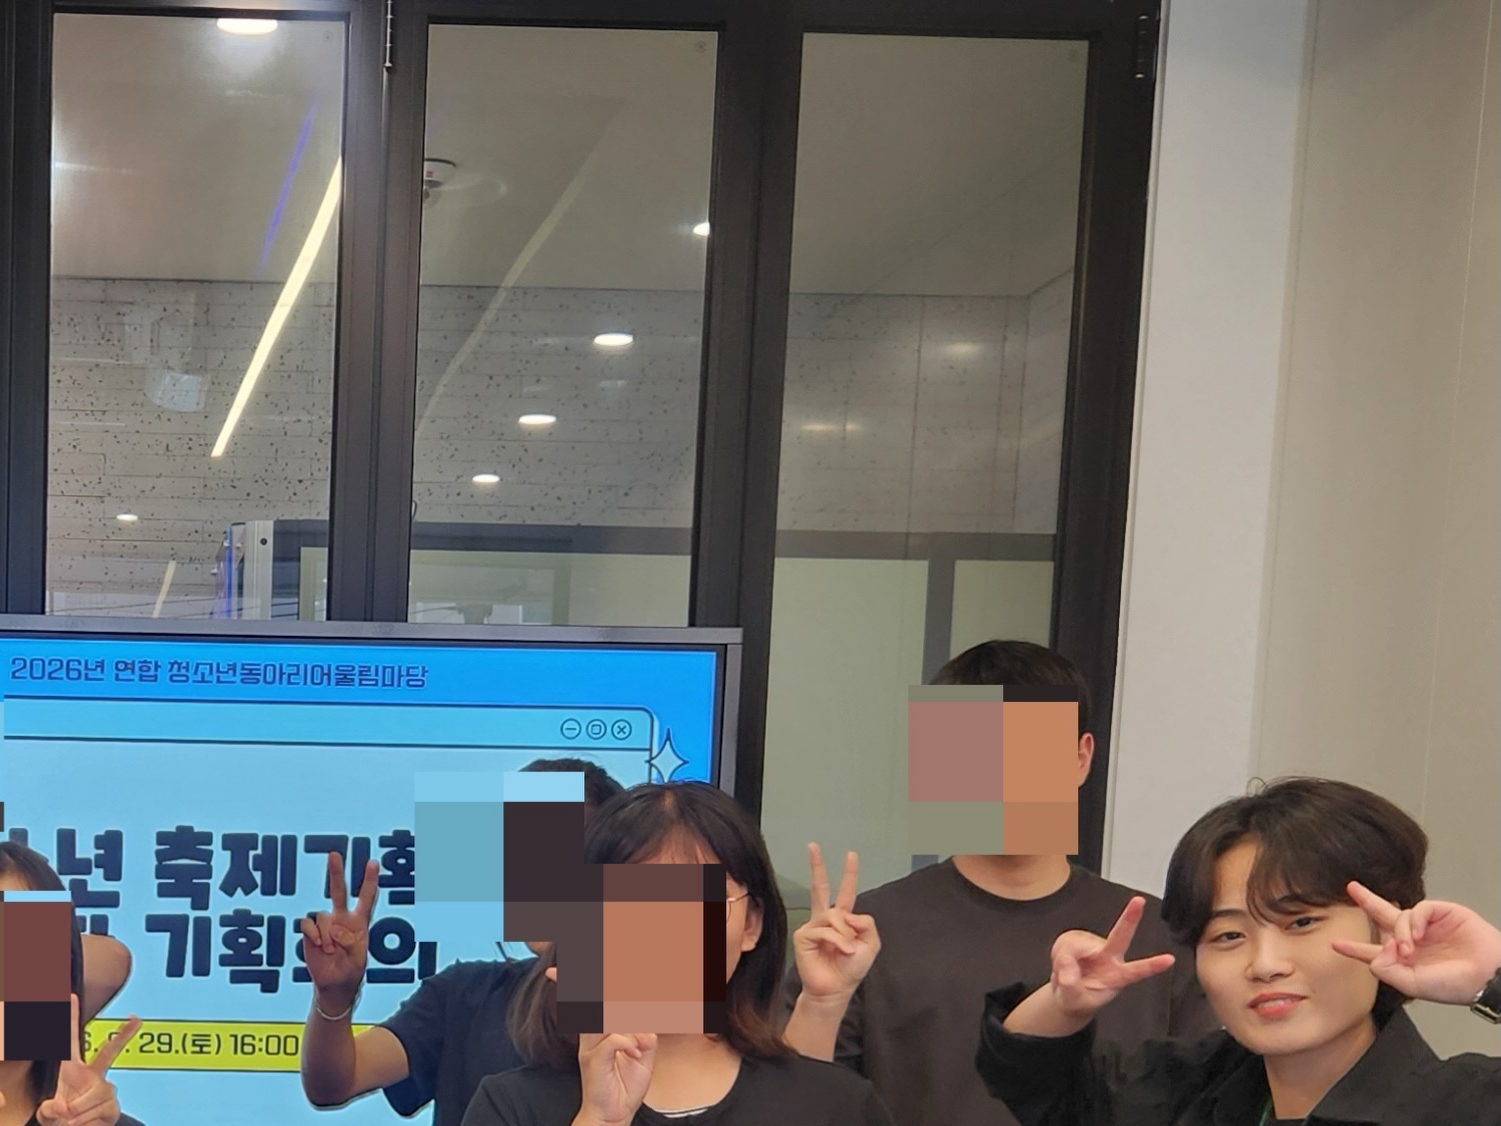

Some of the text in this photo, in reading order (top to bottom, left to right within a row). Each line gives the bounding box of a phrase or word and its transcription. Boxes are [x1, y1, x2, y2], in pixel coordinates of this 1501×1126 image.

[10, 657, 429, 688] 2026년 연합 청소년동아리어울림마당
[139, 1032, 222, 1055] 29.(토)
[229, 1033, 300, 1056] 16:00
